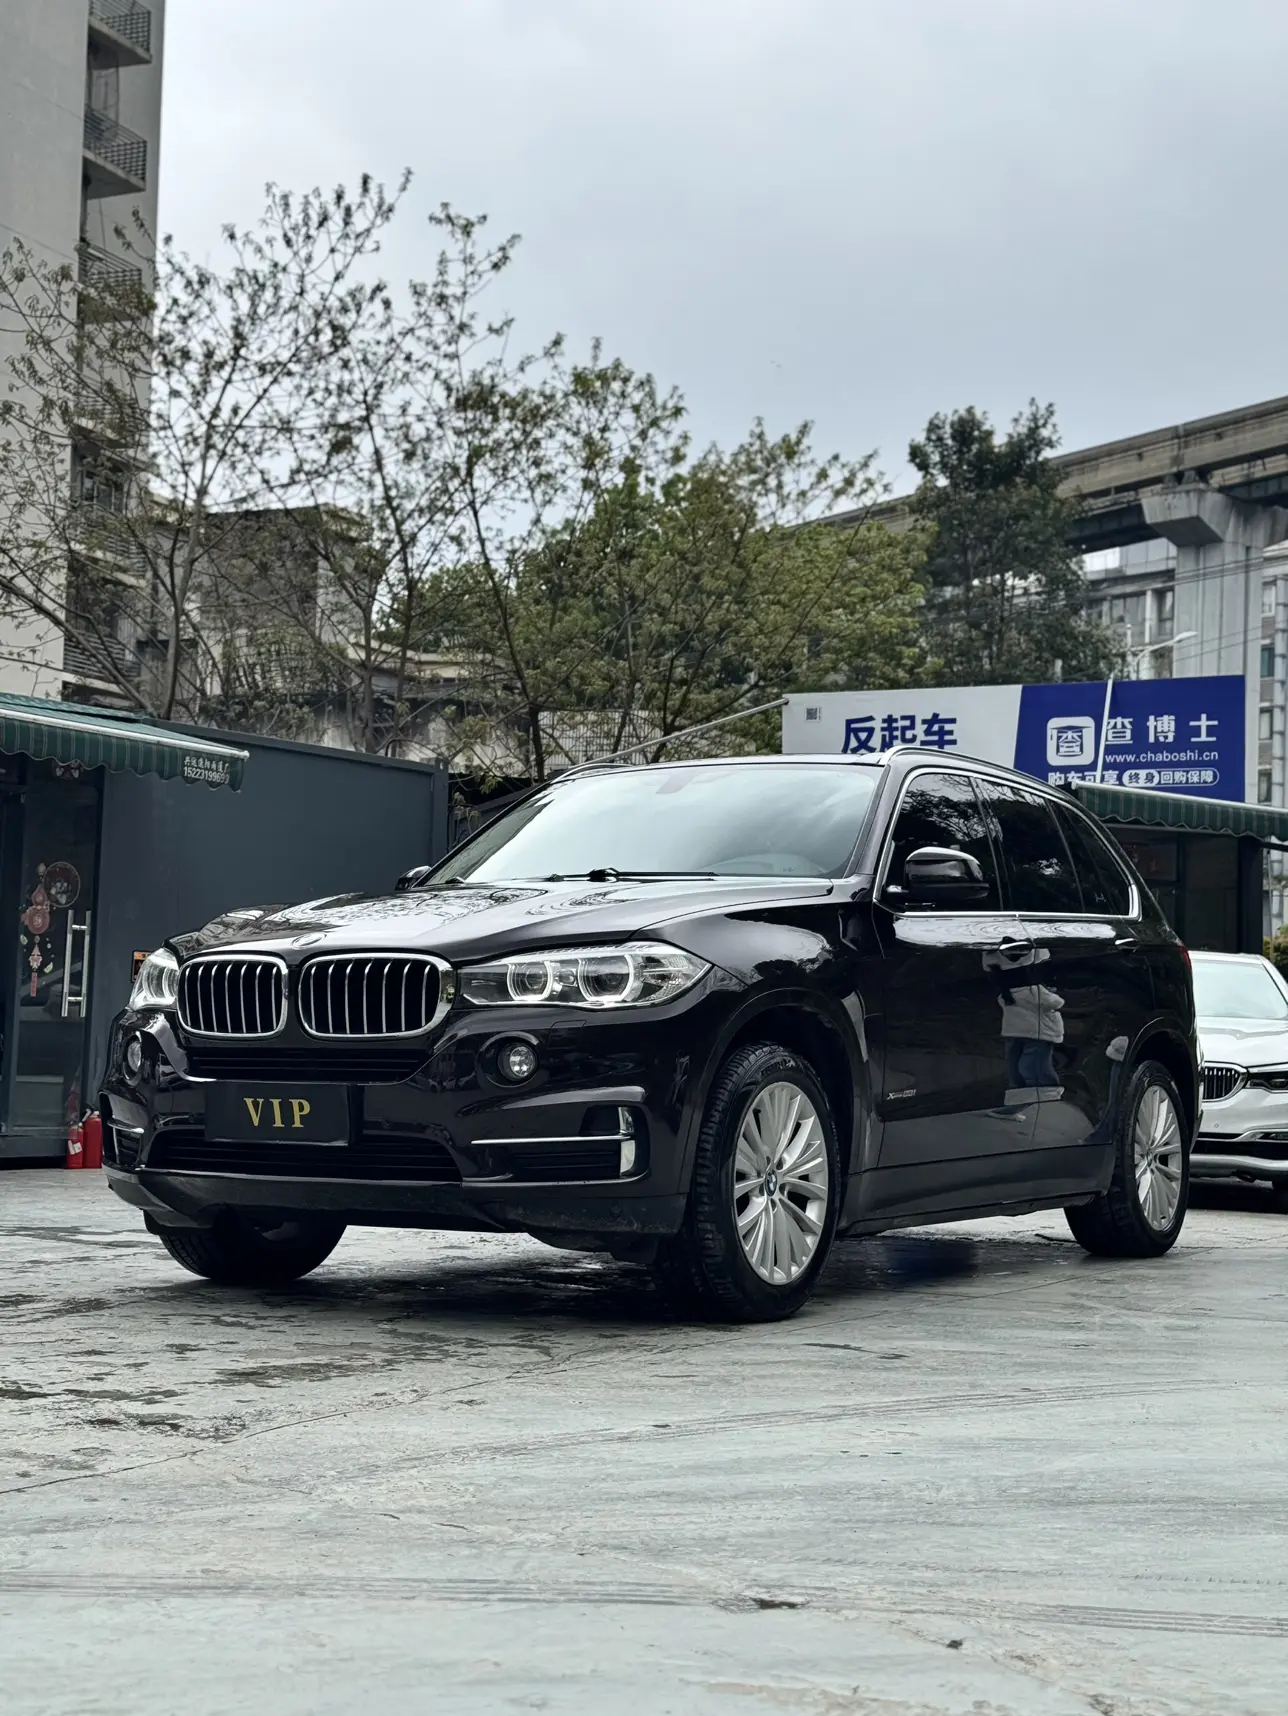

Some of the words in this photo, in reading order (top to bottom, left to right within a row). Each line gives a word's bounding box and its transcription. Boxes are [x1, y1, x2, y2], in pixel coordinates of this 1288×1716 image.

[841, 712, 958, 754] 反起车
[1105, 713, 1219, 745] 查博士
[1105, 749, 1219, 763] www.chaboshi.cn
[243, 1097, 311, 1128] VIP
